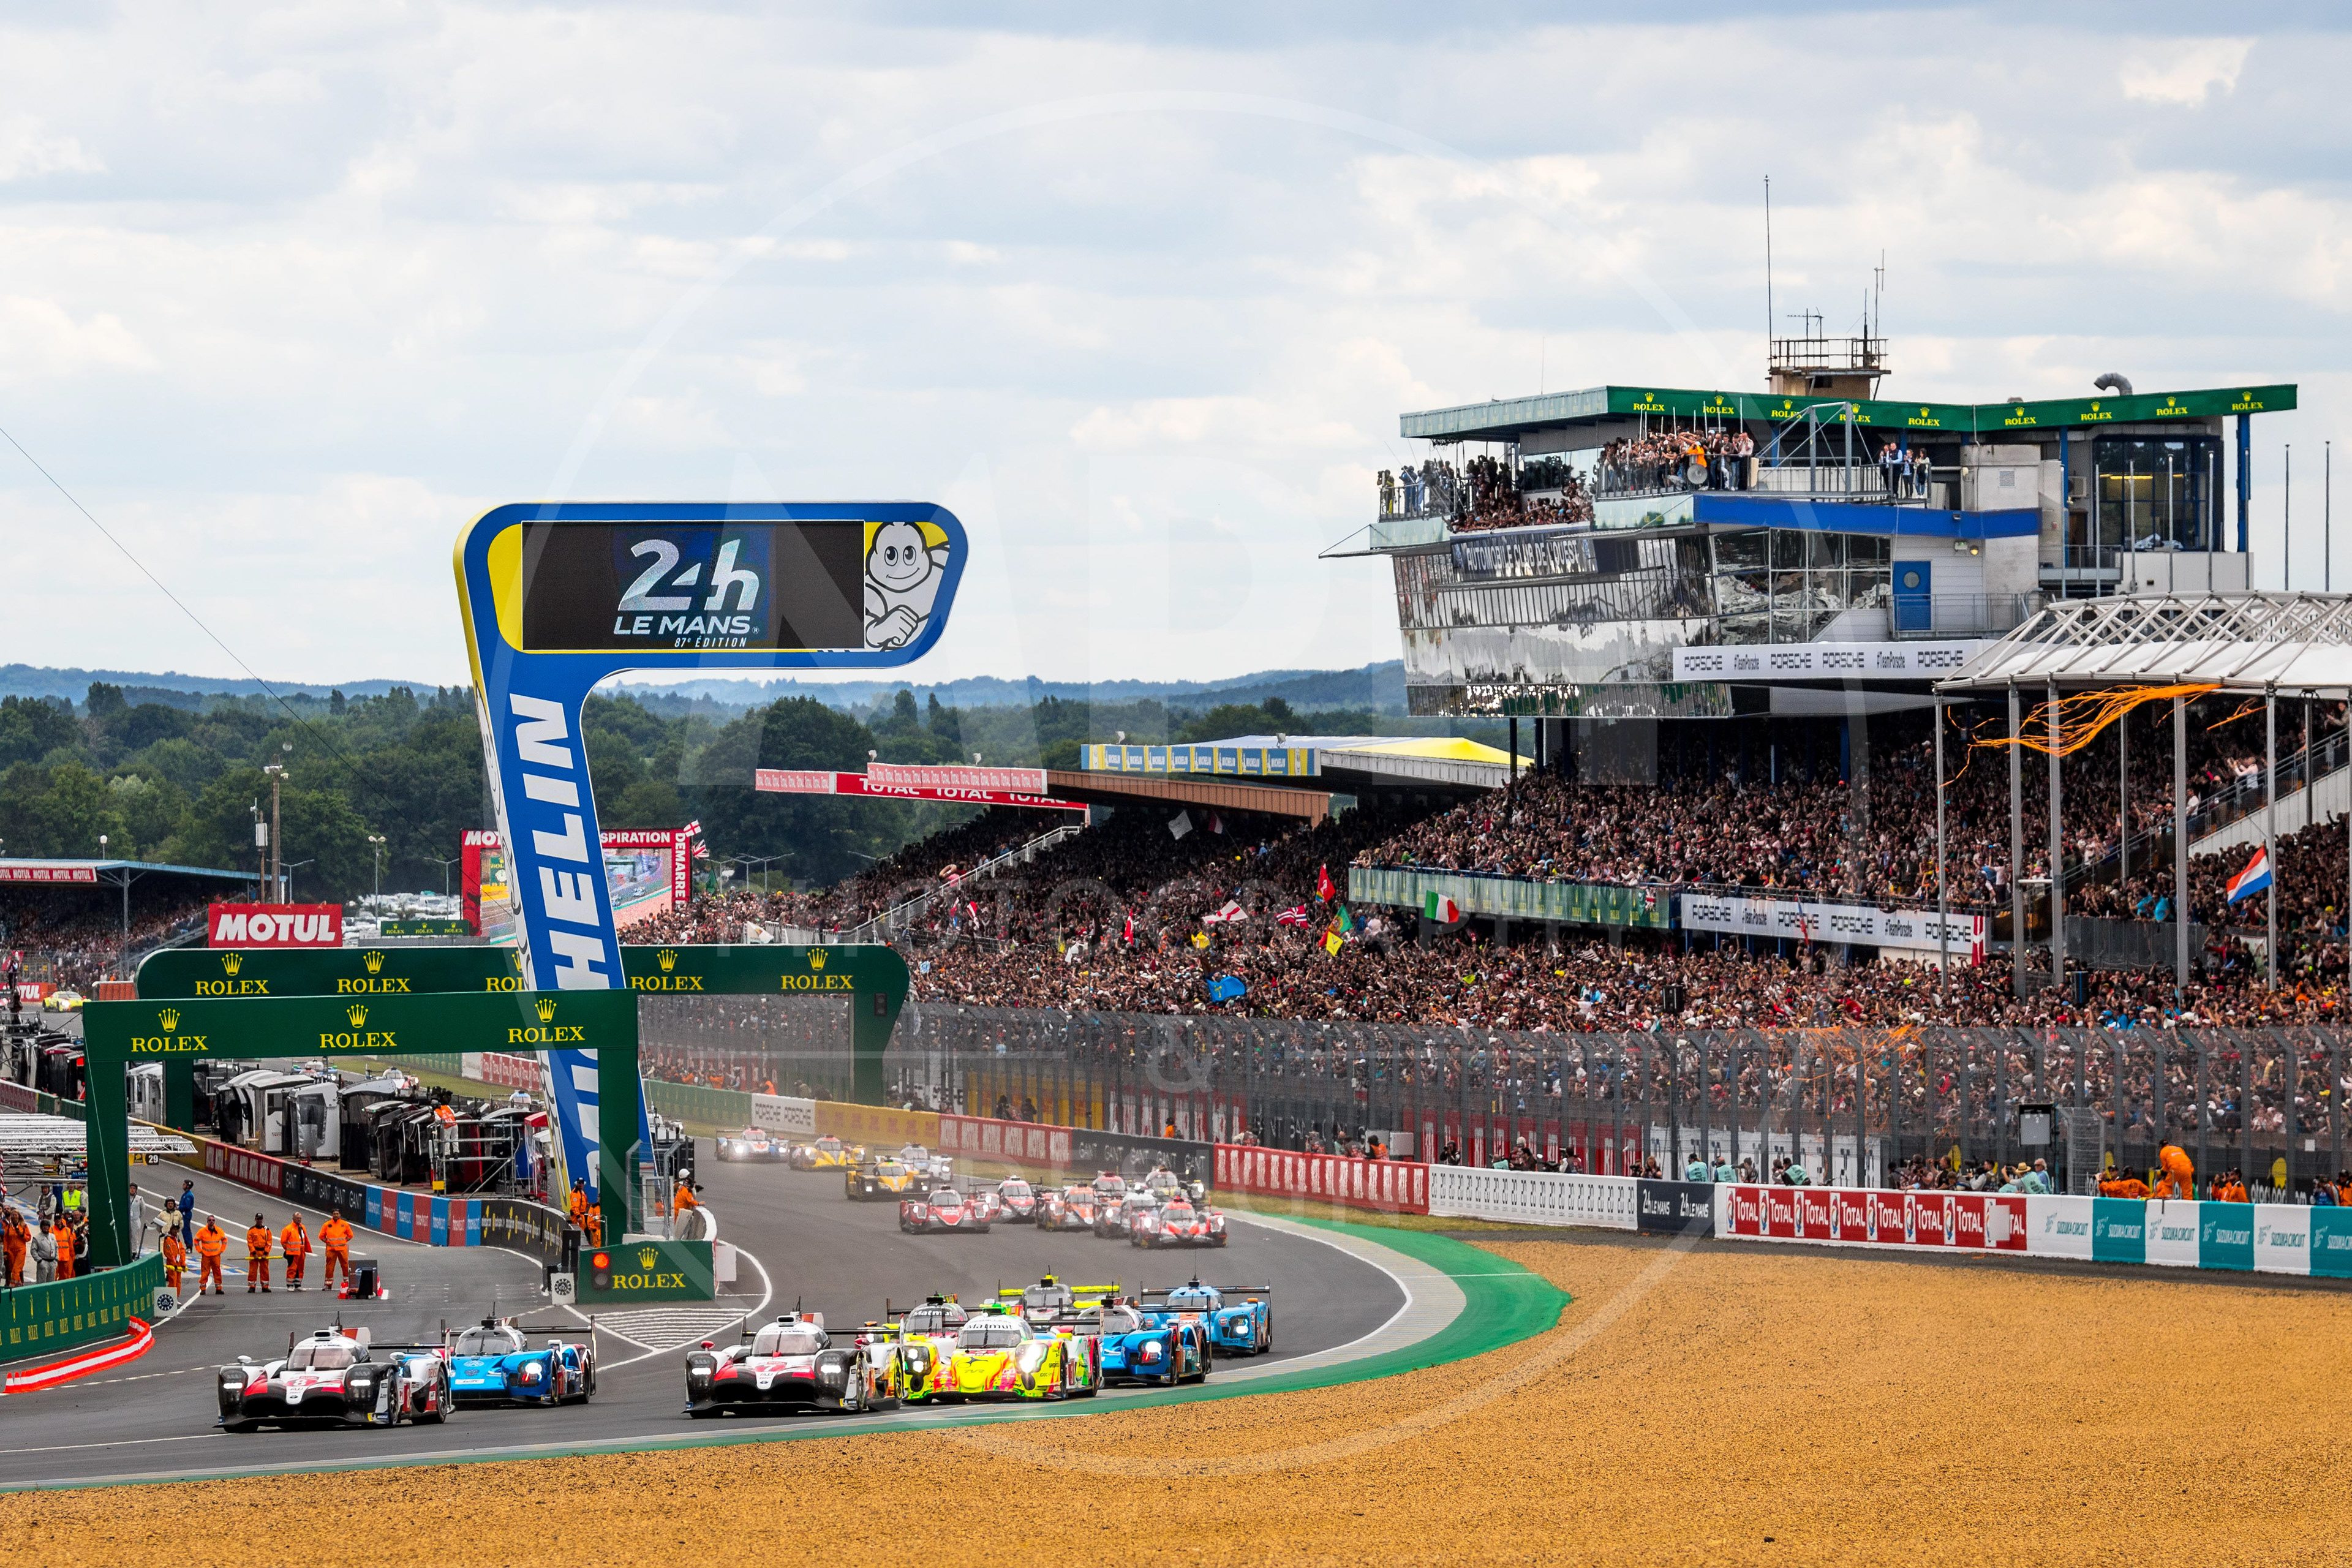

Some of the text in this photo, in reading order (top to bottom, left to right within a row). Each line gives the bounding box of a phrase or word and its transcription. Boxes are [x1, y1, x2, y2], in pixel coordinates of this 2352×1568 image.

[1634, 403, 1665, 412] ROLEX
[1703, 405, 1734, 415] ROLEX
[1839, 414, 1871, 423] RLEX
[1908, 418, 1940, 427] ROLEX
[2005, 417, 2037, 426] ROLEX
[2081, 411, 2112, 421] ROLEX
[2156, 406, 2188, 416] ROLEX
[2231, 401, 2263, 410] ROLEX
[1466, 544, 1513, 571] AUTOMOBILE
[618, 539, 759, 611] 24h
[614, 616, 654, 635] LE
[695, 635, 747, 647] ÉDITION
[1684, 655, 1722, 671] PORSCHE
[1771, 652, 1812, 669] PORSCHE
[1822, 652, 1864, 668] PORSCHE
[1917, 650, 1963, 668] PORSCHE
[465, 831, 501, 846] MOT
[13, 869, 31, 880] MOTUL
[33, 869, 51, 880] MOTUL
[53, 869, 70, 880] MOTUL
[72, 869, 91, 880] MOTUL
[676, 832, 685, 899] DEMARRE
[215, 913, 336, 941] MOTUL
[1692, 904, 1731, 922] PORSCHE
[1831, 914, 1873, 935] PORSCHE
[195, 979, 270, 995] ROLEX
[336, 978, 411, 993] ROLEX
[630, 976, 704, 990] ROLEX
[781, 974, 854, 990] ROLEX
[131, 1026, 586, 1052] ROLEX ROLEX ROLEX
[59, 1164, 66, 1175] 29
[148, 1155, 159, 1164] 29
[349, 1190, 362, 1210] GANT
[1736, 1196, 2025, 1235] TOTAL TOTAL TOTAL TOTAL TOTAL TOTAL TOTAL TAL
[612, 1273, 686, 1290] ROLEX
